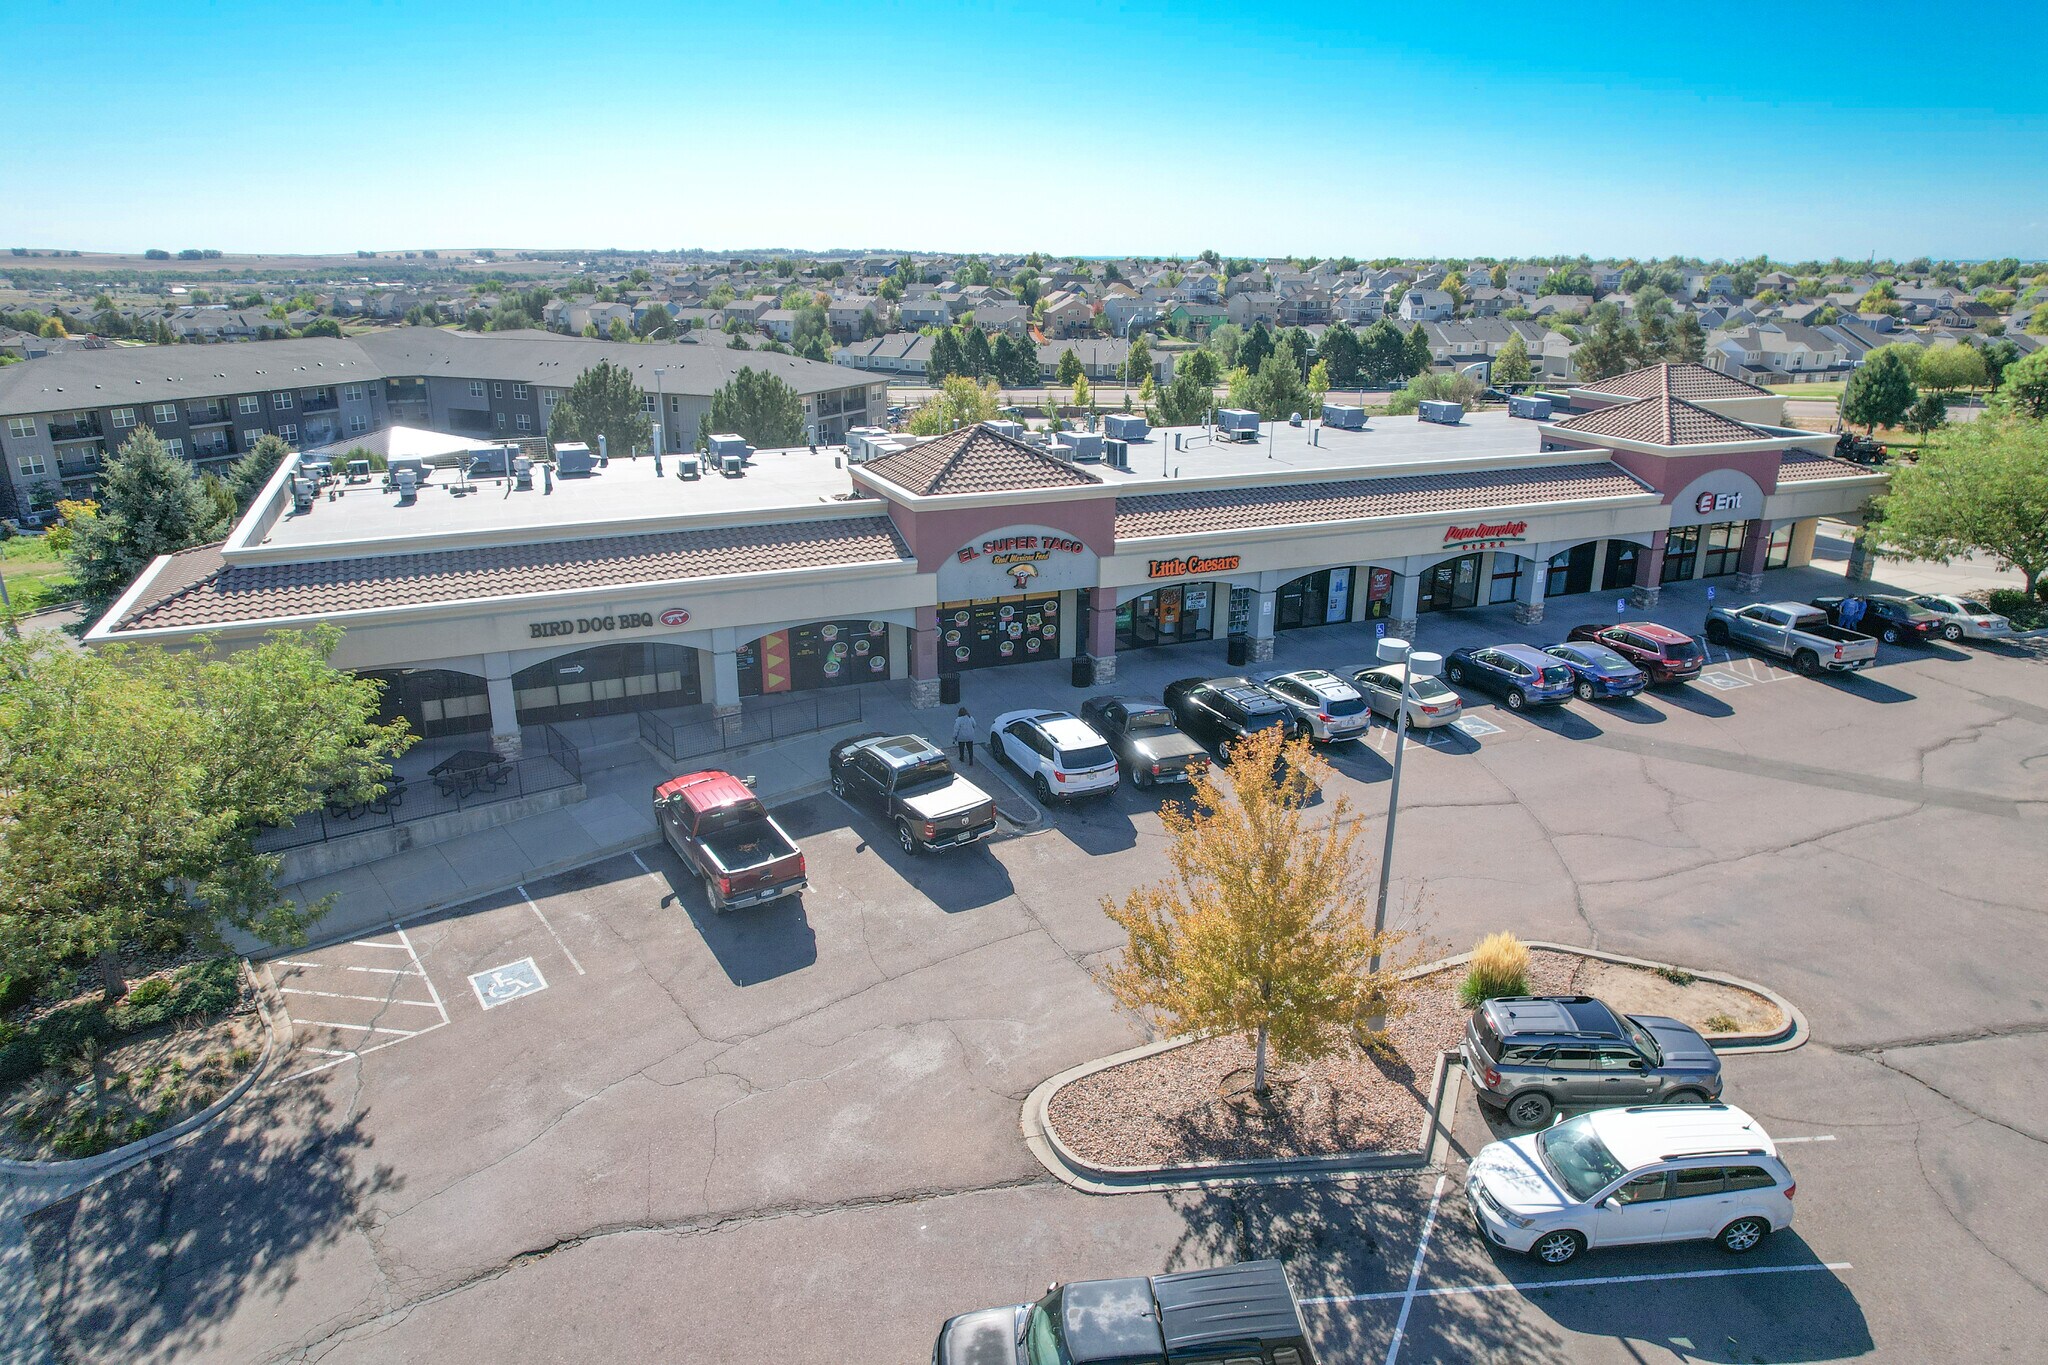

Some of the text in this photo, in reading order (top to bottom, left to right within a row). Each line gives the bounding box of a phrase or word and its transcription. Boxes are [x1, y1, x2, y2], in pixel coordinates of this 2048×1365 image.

[1714, 492, 1742, 510] Ent
[1444, 521, 1527, 542] Papa Murphy's
[957, 536, 1084, 564] EL SUPER TACO
[1462, 541, 1505, 551] PIZZA
[992, 551, 1050, 564] Real Mexican Food
[1149, 555, 1240, 578] Little Caesars
[529, 612, 654, 639] BIRD DOG BBQ
